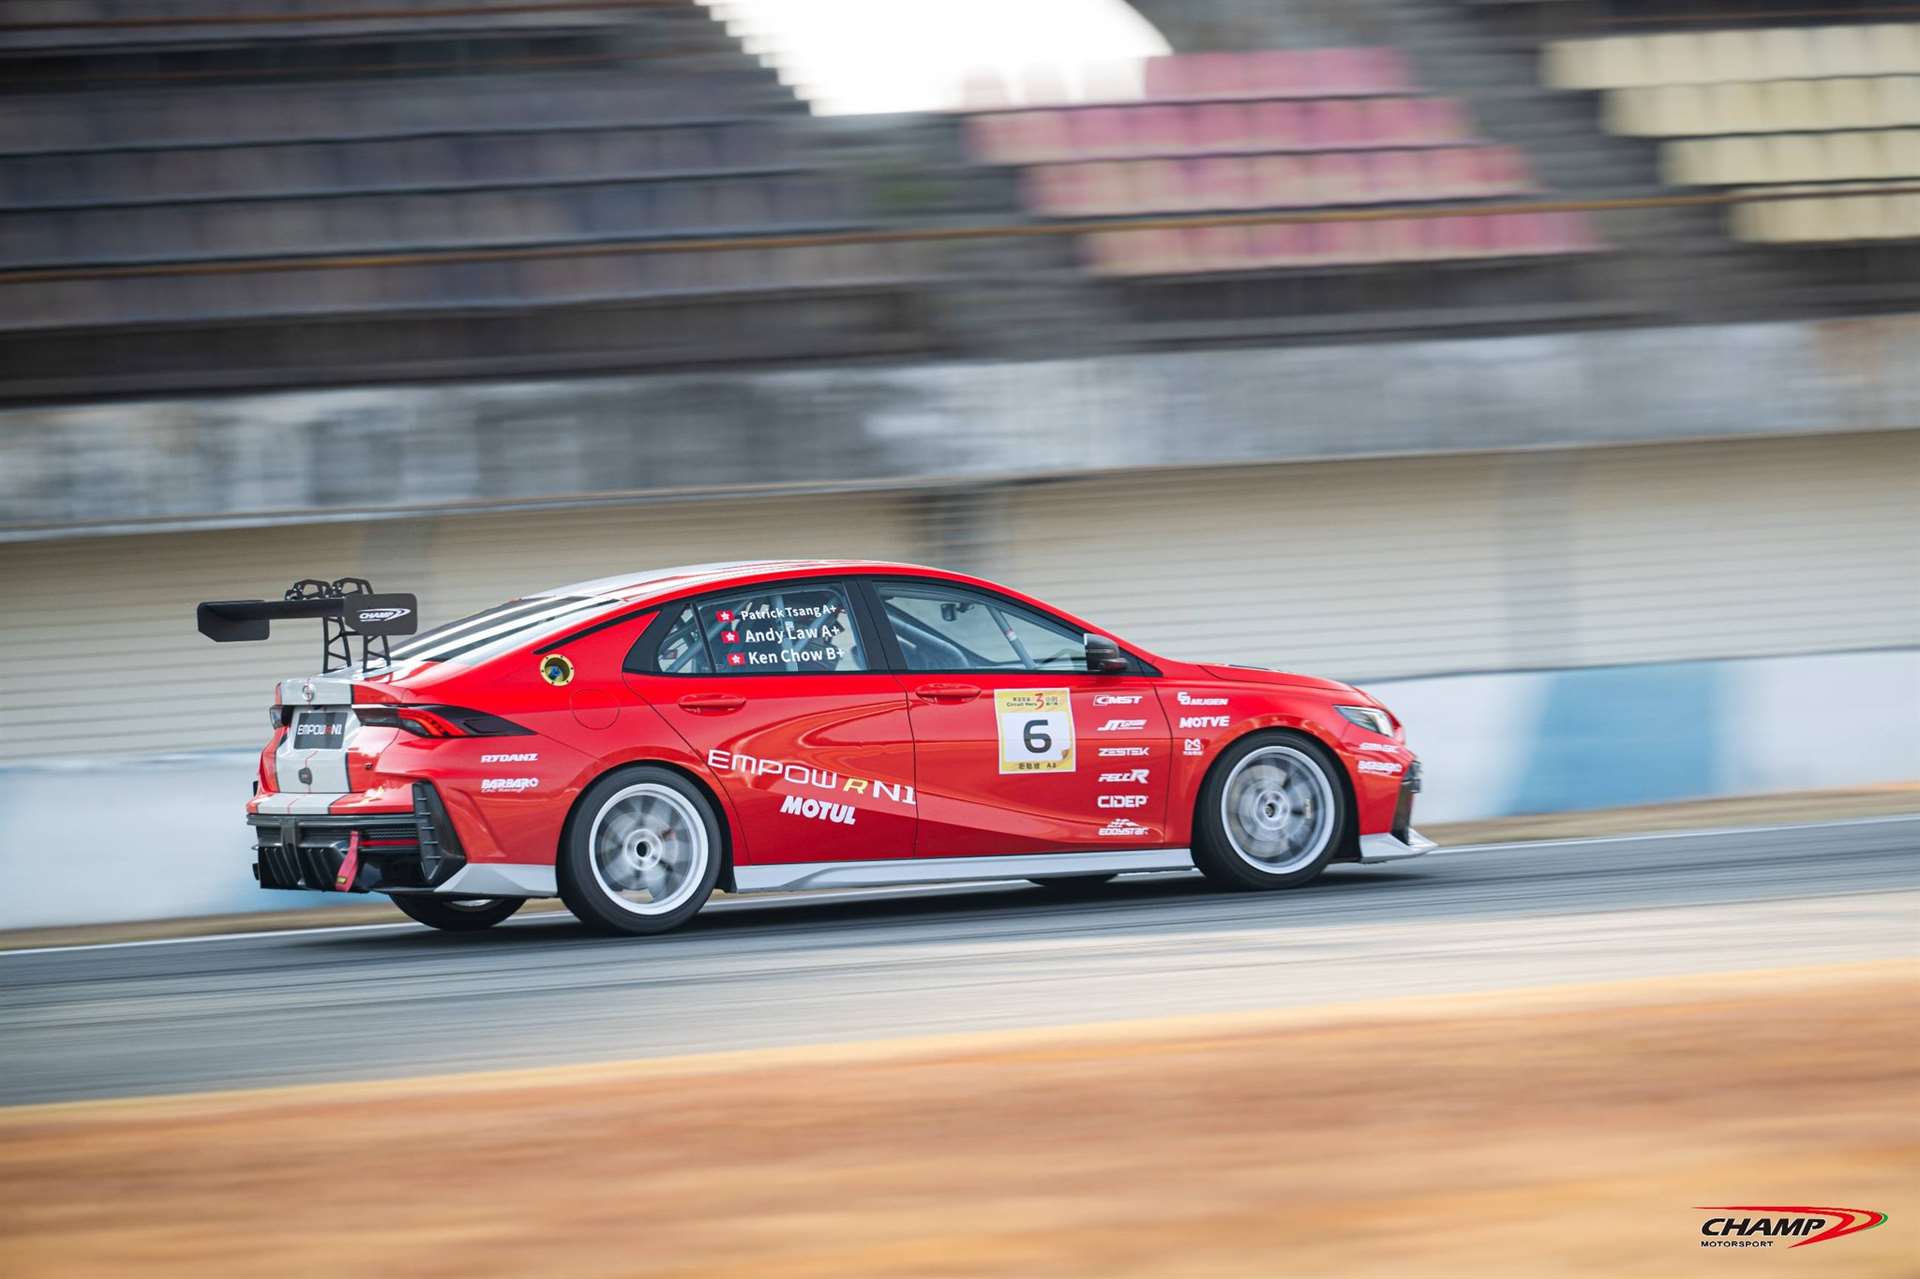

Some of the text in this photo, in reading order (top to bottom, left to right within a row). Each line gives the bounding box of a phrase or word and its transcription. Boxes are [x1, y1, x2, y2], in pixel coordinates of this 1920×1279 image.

[740, 604, 837, 621] Patrick Tsang A+
[745, 624, 840, 645] Andy Law A+
[748, 647, 845, 665] Ken Chow B+
[1179, 715, 1230, 728] MOTVE
[1023, 719, 1052, 754] 6
[780, 795, 857, 825] MOTUL
[1097, 794, 1149, 808] CIDEP
